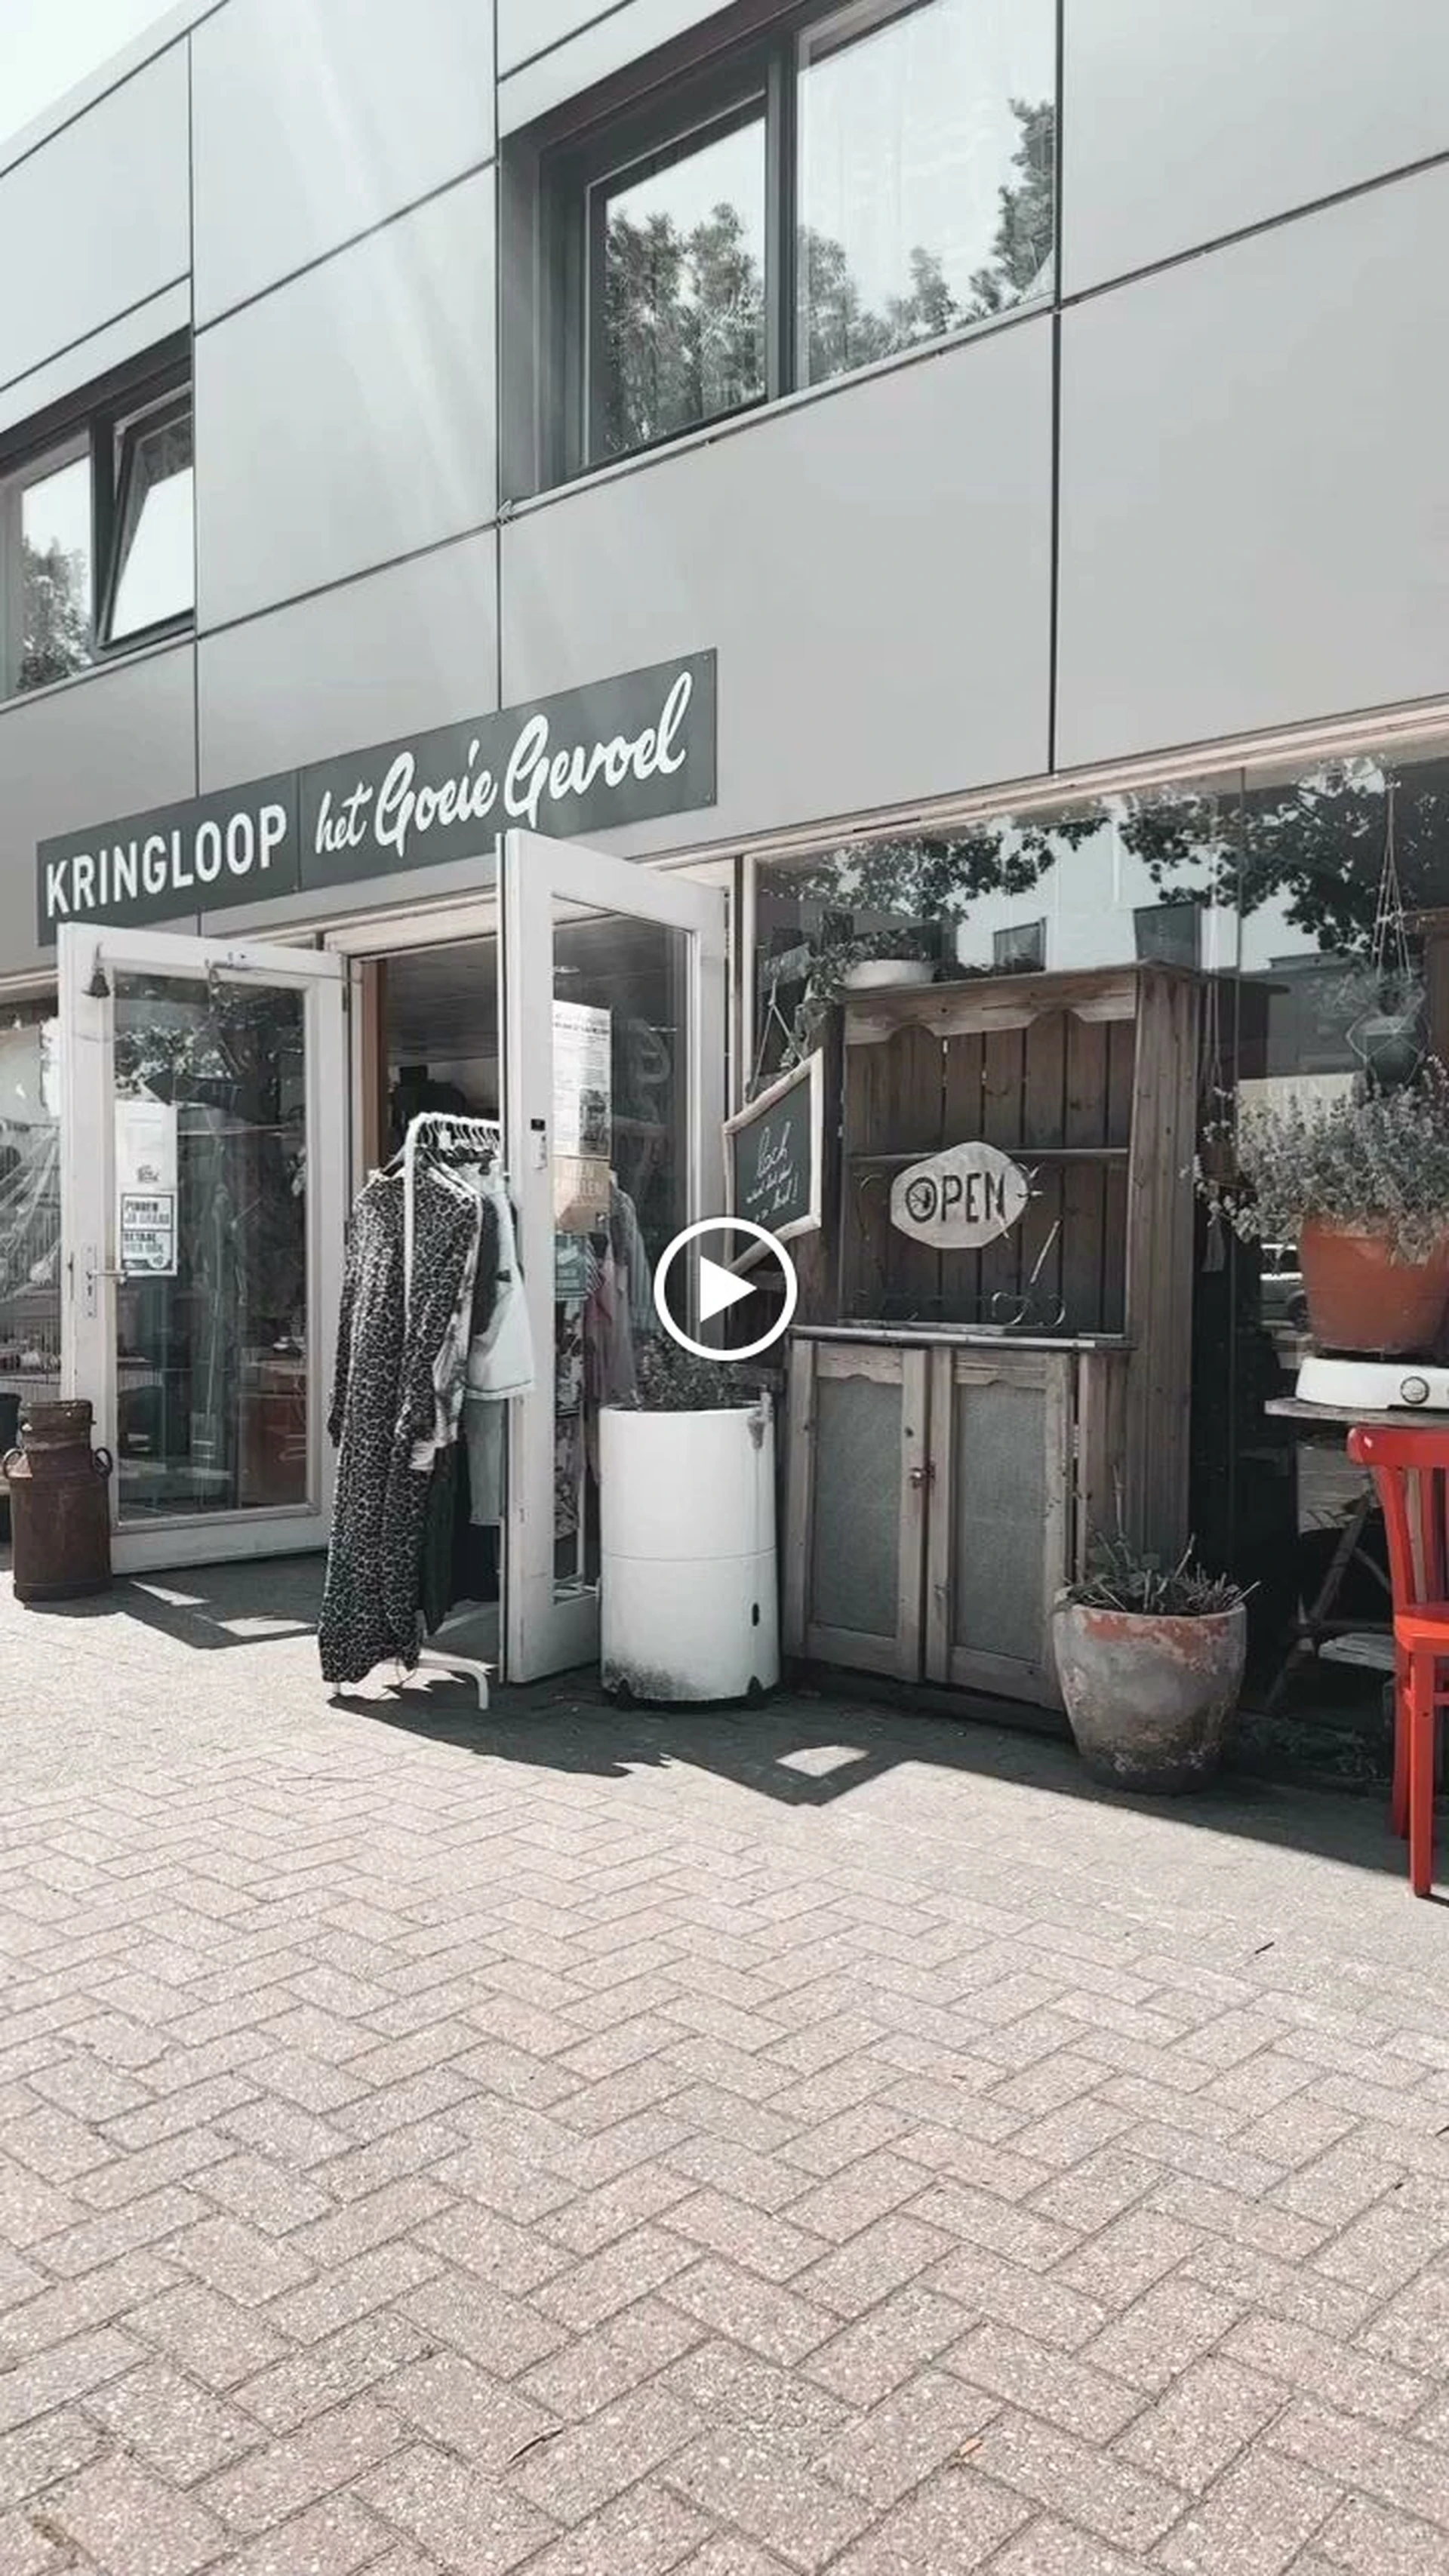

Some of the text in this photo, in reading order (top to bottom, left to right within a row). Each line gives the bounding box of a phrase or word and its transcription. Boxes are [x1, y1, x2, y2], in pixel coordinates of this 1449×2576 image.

[46, 671, 693, 917] KRINGLOOP het Goeie Gevoel
[905, 1171, 1008, 1223] OPEN
